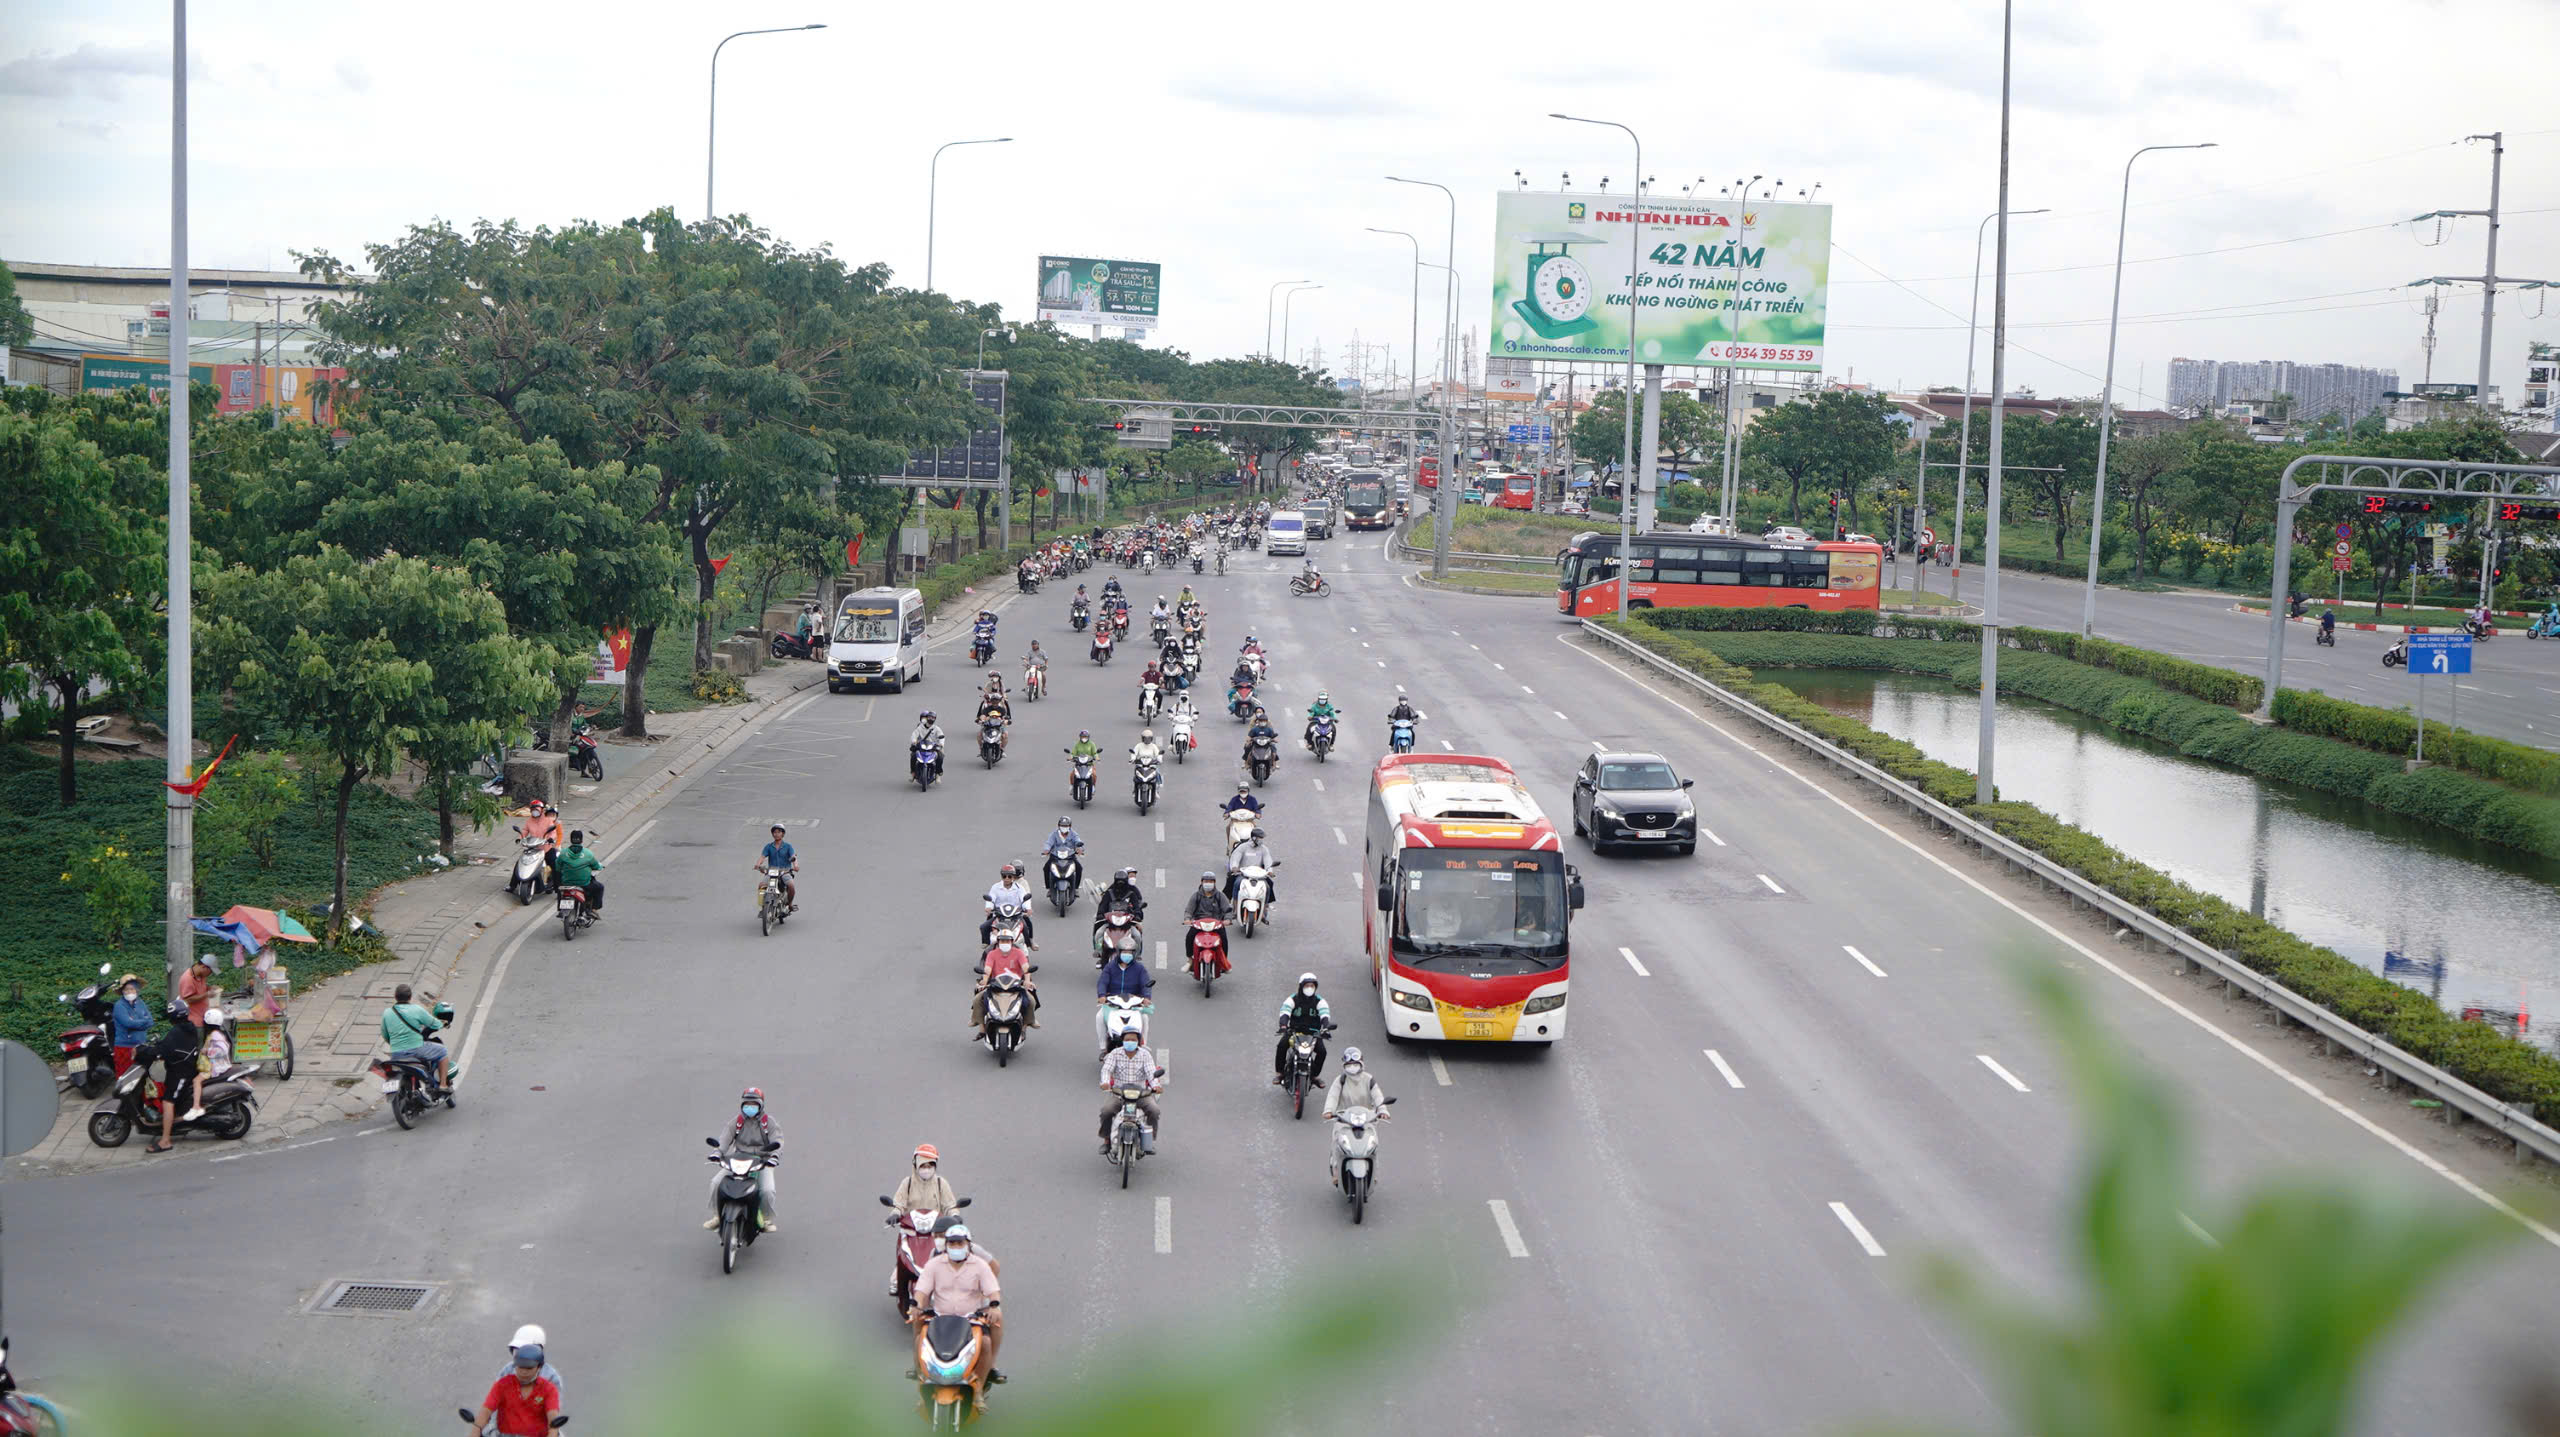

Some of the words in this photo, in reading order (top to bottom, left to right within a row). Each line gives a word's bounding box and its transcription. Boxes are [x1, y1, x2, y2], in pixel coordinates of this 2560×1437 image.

[1649, 242, 1688, 267] 42
[1693, 239, 1766, 269] NĂM
[1624, 272, 1653, 287] TẾP
[1656, 272, 1684, 289] NỐI
[1688, 276, 1737, 292] THÀNH
[1742, 279, 1788, 293] CÔNG
[1664, 293, 1719, 310] NGỪNG
[1765, 297, 1804, 313] TRIỂN
[1725, 346, 1758, 359] 0934
[1760, 348, 1777, 360] 39
[1779, 349, 1794, 360] 55
[1797, 350, 1814, 361] 39
[2364, 496, 2386, 514] 32
[2500, 503, 2522, 521] 32
